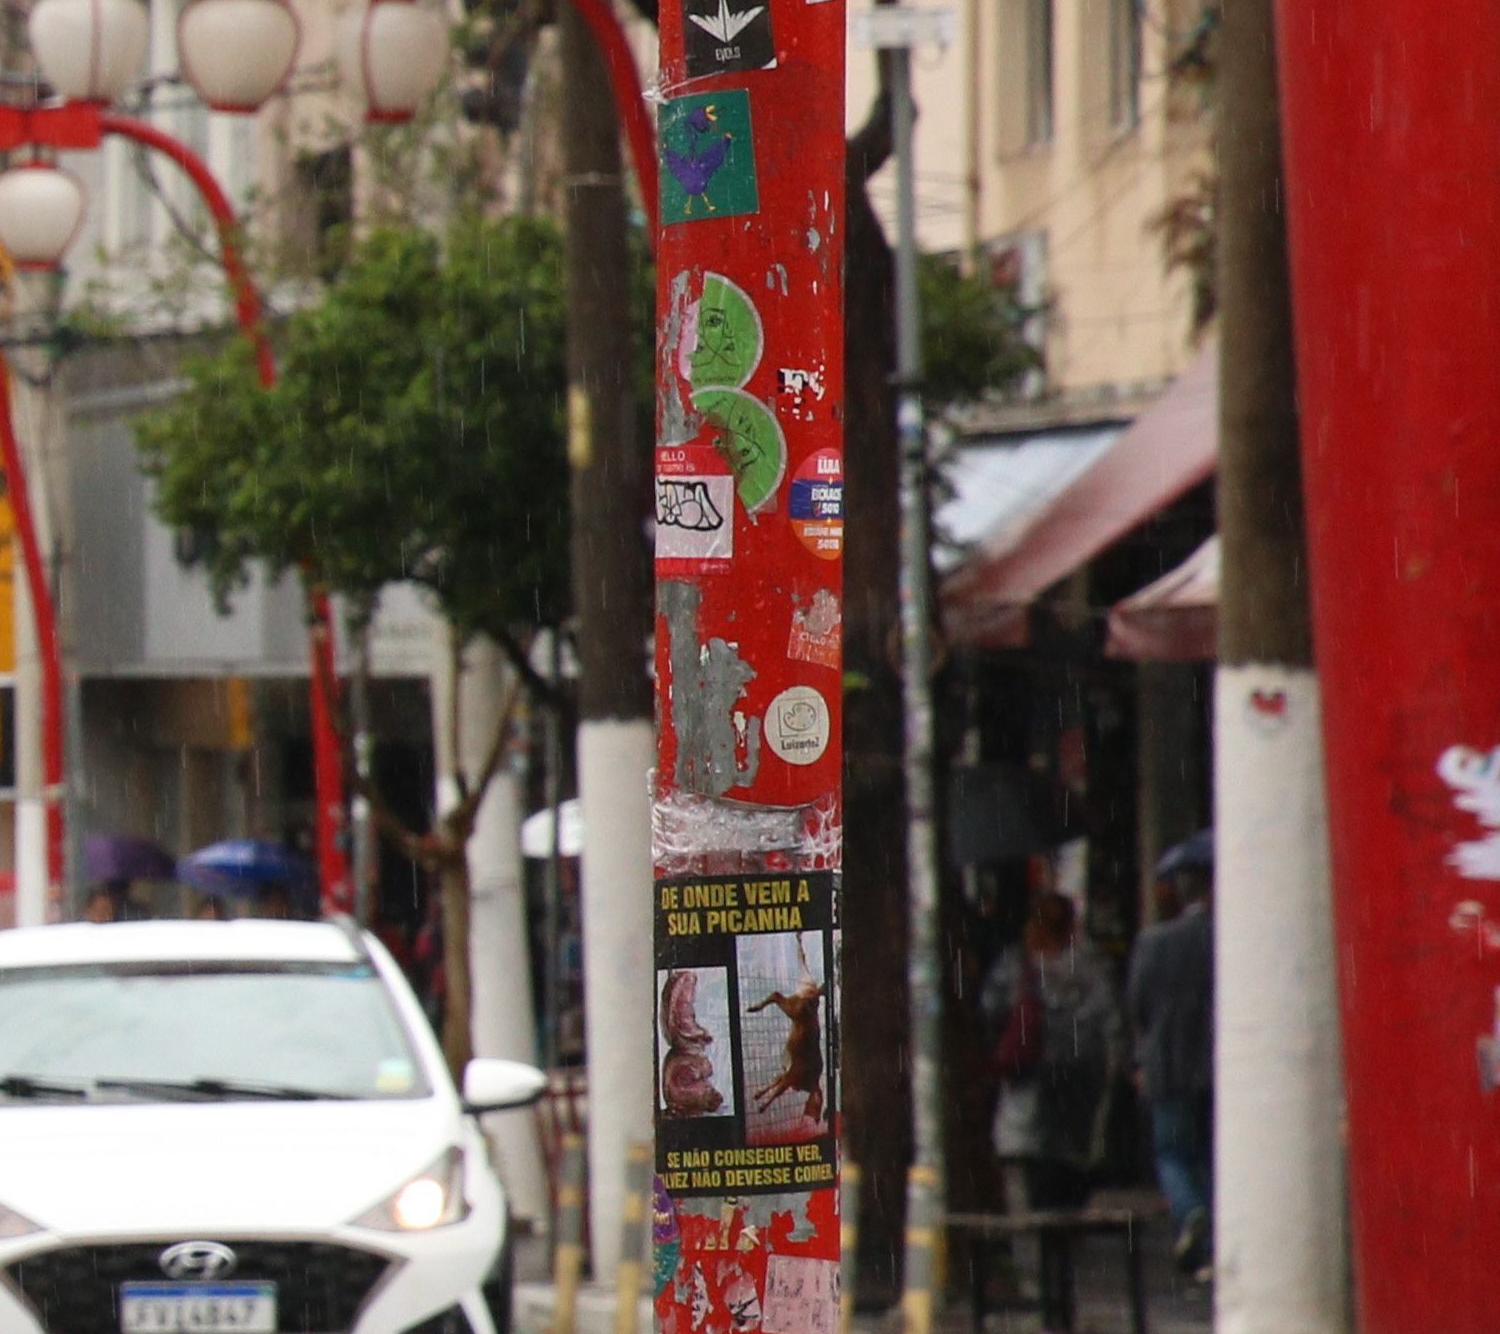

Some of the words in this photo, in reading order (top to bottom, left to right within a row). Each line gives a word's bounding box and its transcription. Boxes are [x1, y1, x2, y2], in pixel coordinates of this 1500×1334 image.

[661, 886, 679, 910] DE
[683, 883, 739, 909] ONDE
[743, 880, 791, 906] VEM
[797, 879, 811, 903] A
[667, 912, 702, 936] SUA
[706, 906, 803, 934] PICANHA
[667, 1151, 681, 1169] SE
[683, 1148, 711, 1167] NÃO
[714, 1147, 794, 1167] CONSEGUE
[692, 1169, 722, 1188] NÃO
[725, 1167, 791, 1187] DEVESSE
